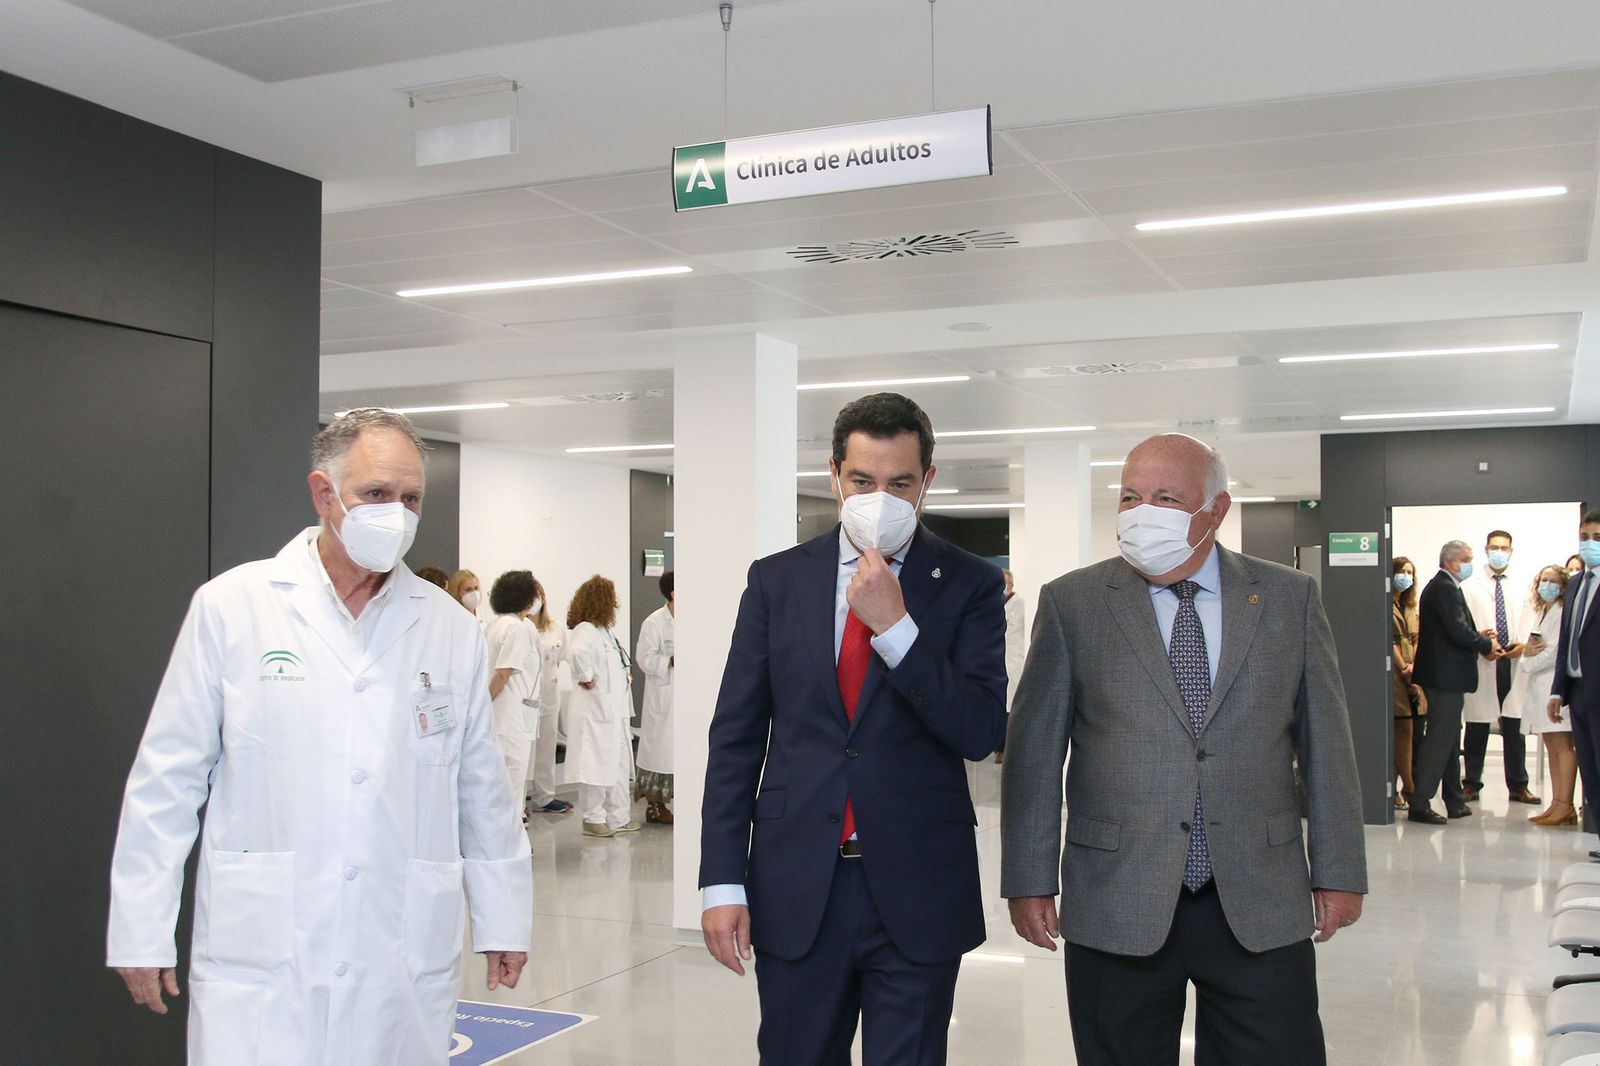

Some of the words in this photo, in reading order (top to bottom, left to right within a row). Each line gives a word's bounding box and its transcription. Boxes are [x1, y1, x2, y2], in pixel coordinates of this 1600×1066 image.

[736, 155, 808, 180] Clínica
[814, 150, 840, 171] de
[846, 141, 932, 168] Adultos
[1360, 536, 1370, 551] 8
[473, 1015, 535, 1028] Espacio
